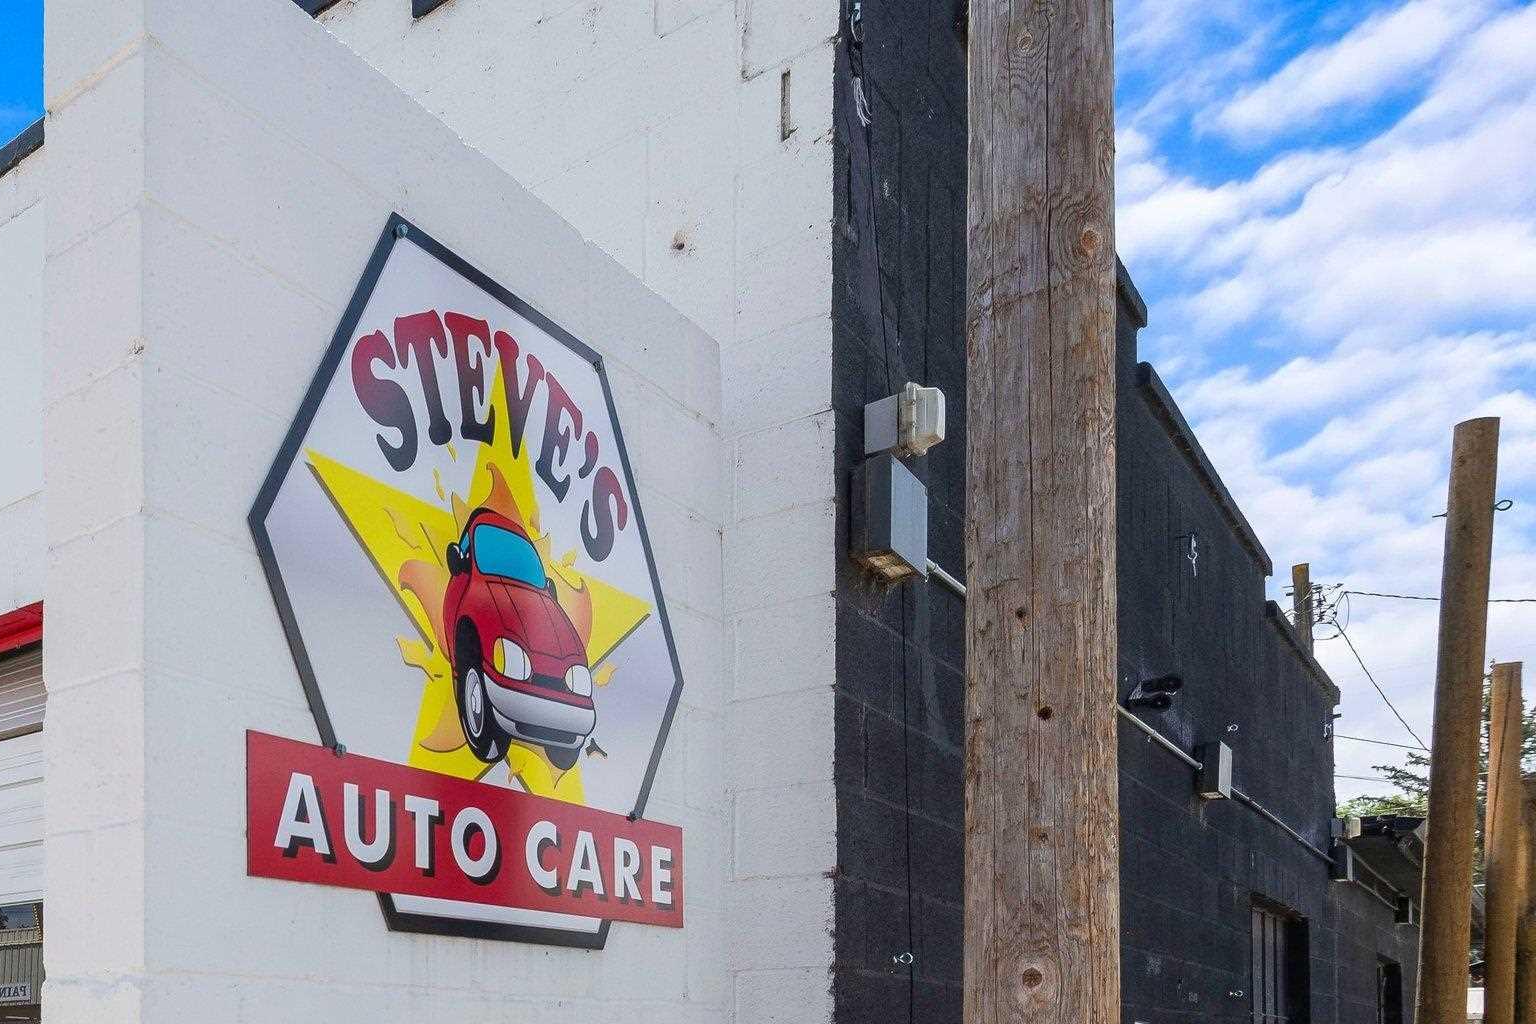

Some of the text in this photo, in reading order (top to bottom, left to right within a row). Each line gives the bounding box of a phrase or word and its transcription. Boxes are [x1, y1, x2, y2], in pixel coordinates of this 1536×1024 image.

[351, 309, 628, 562] STEVE'S
[273, 772, 676, 911] AUTO CARE
